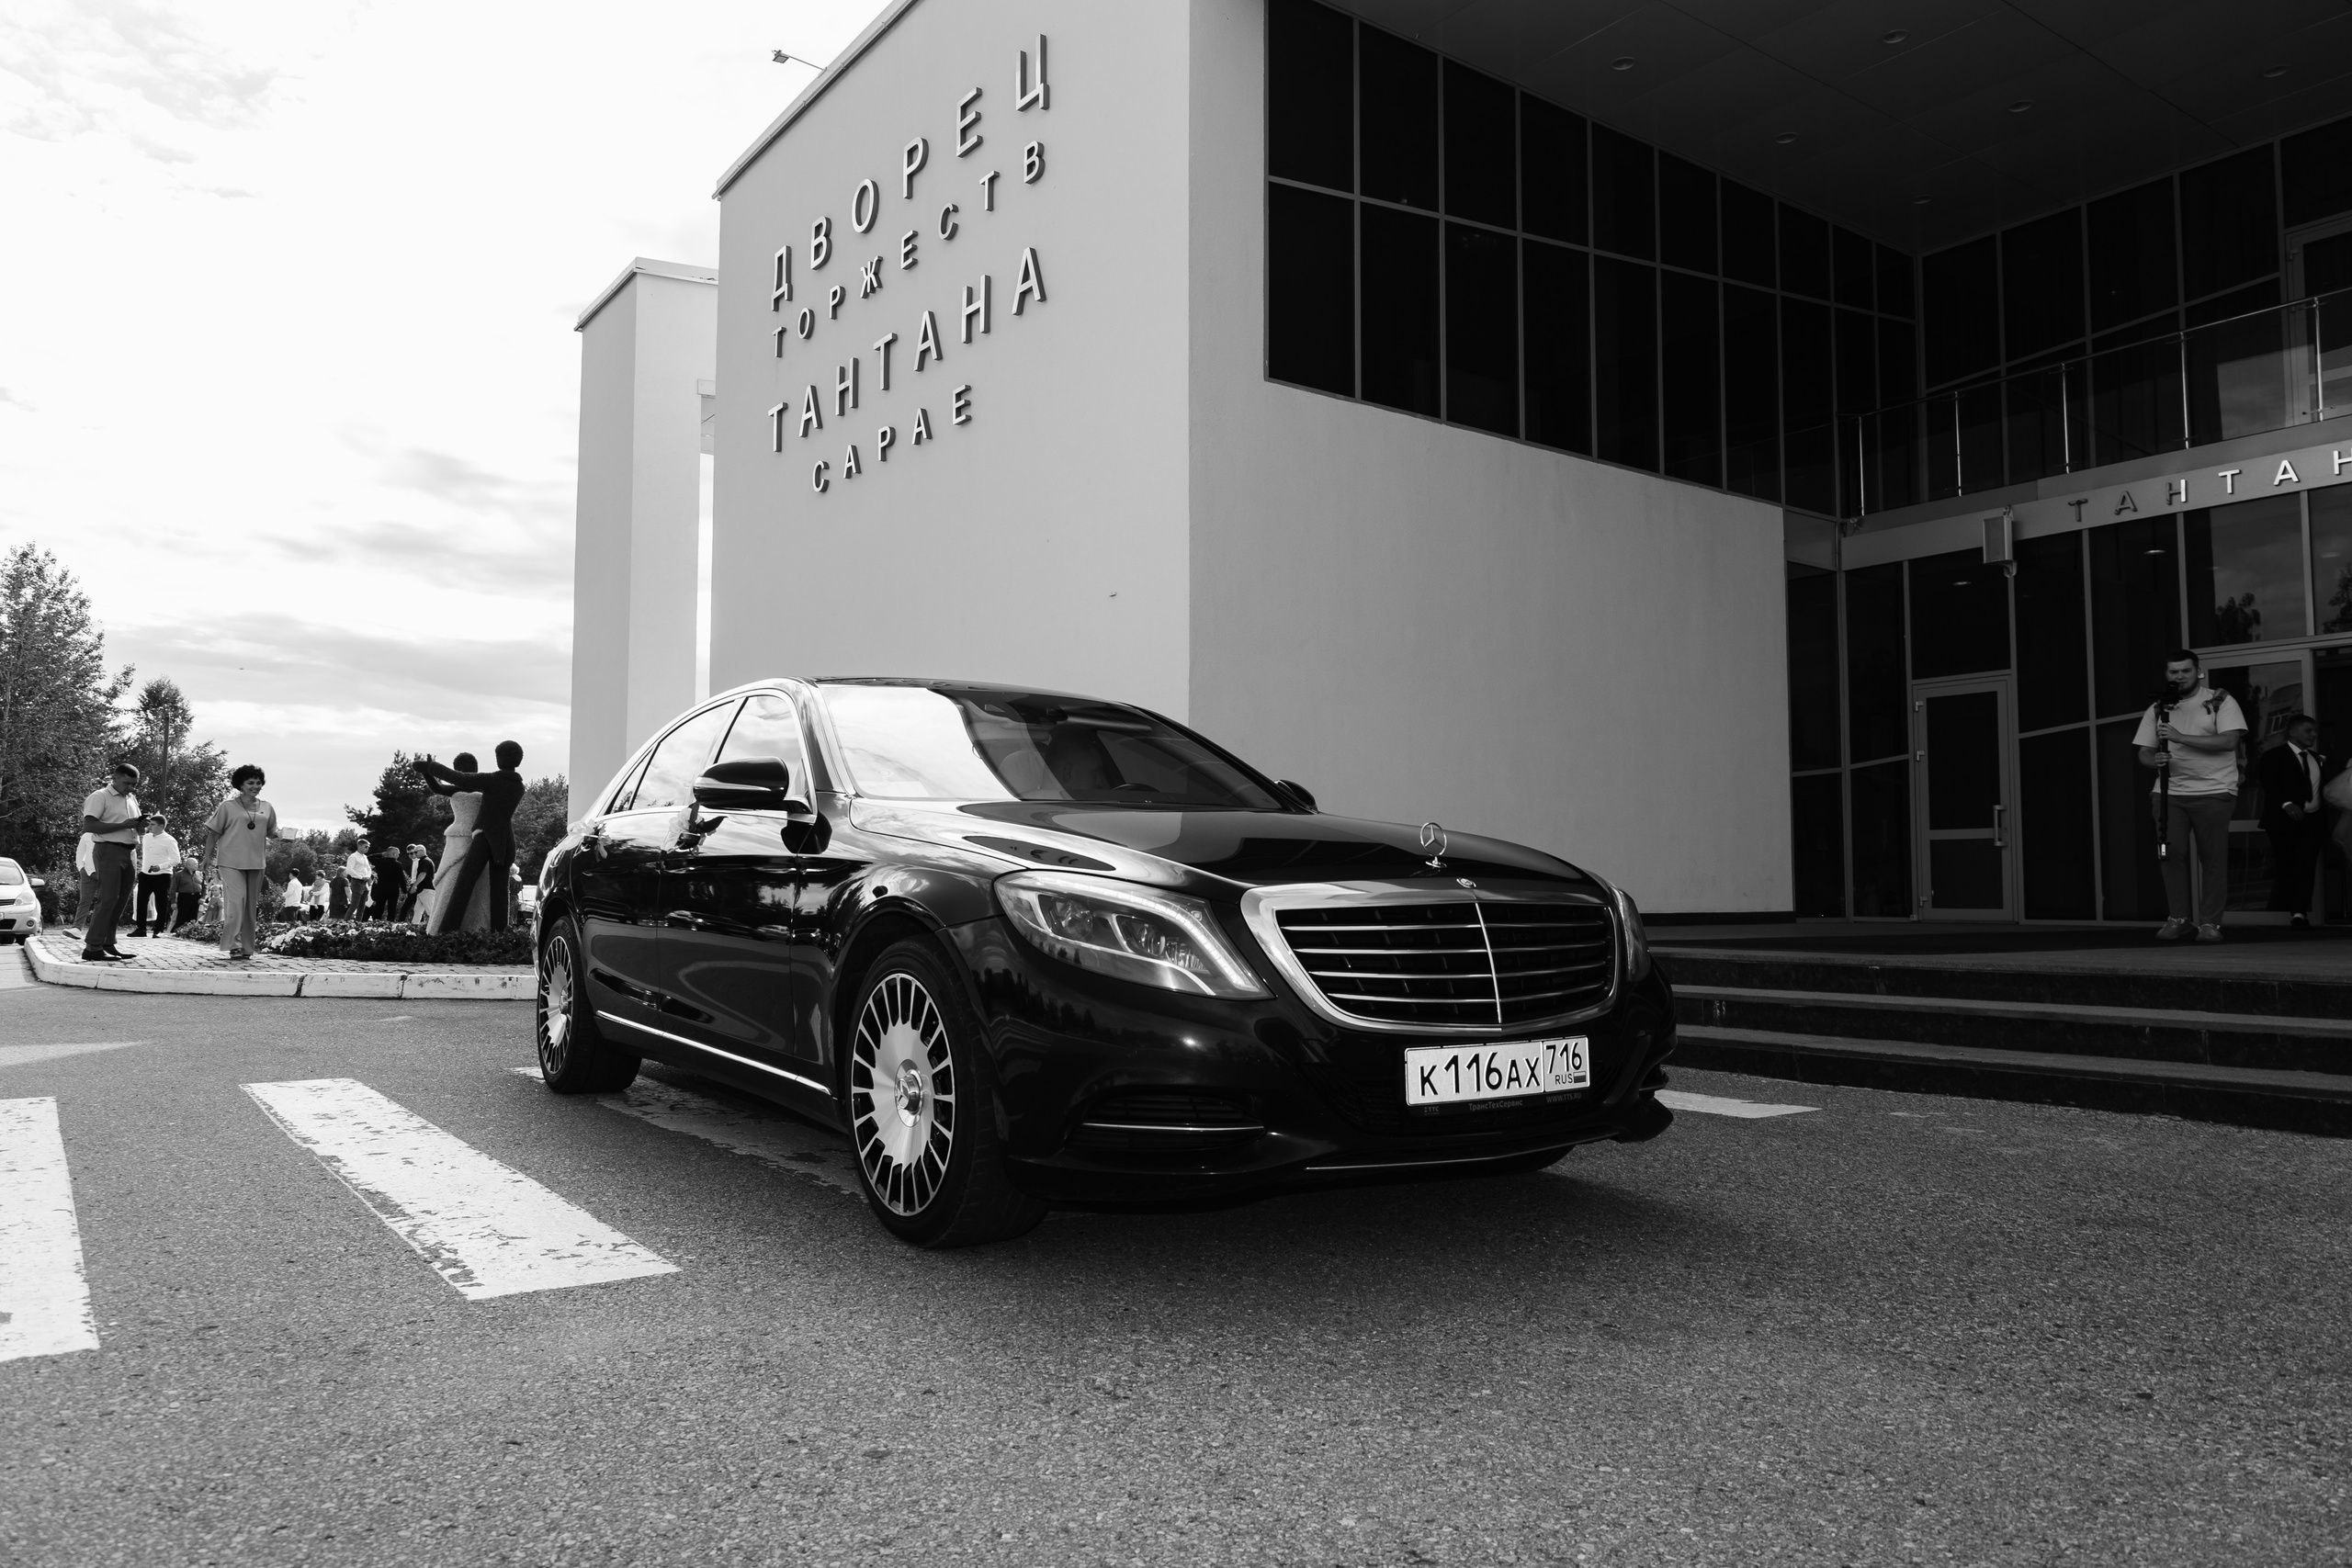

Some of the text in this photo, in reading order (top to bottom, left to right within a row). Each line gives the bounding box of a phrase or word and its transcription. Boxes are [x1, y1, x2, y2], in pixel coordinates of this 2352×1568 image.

[772, 34, 1049, 310] ДВОРЕЦ
[773, 141, 1045, 357] ТОРЖЕСТВ
[768, 247, 1046, 452] ТАНТАНА
[813, 385, 971, 492] САРАЕ
[1545, 1042, 1583, 1074] 716
[1555, 1073, 1573, 1085] RUS
[1468, 1099, 1523, 1111] ТрансТехСервис
[1546, 1091, 1582, 1103] WWW.TTS.RU
